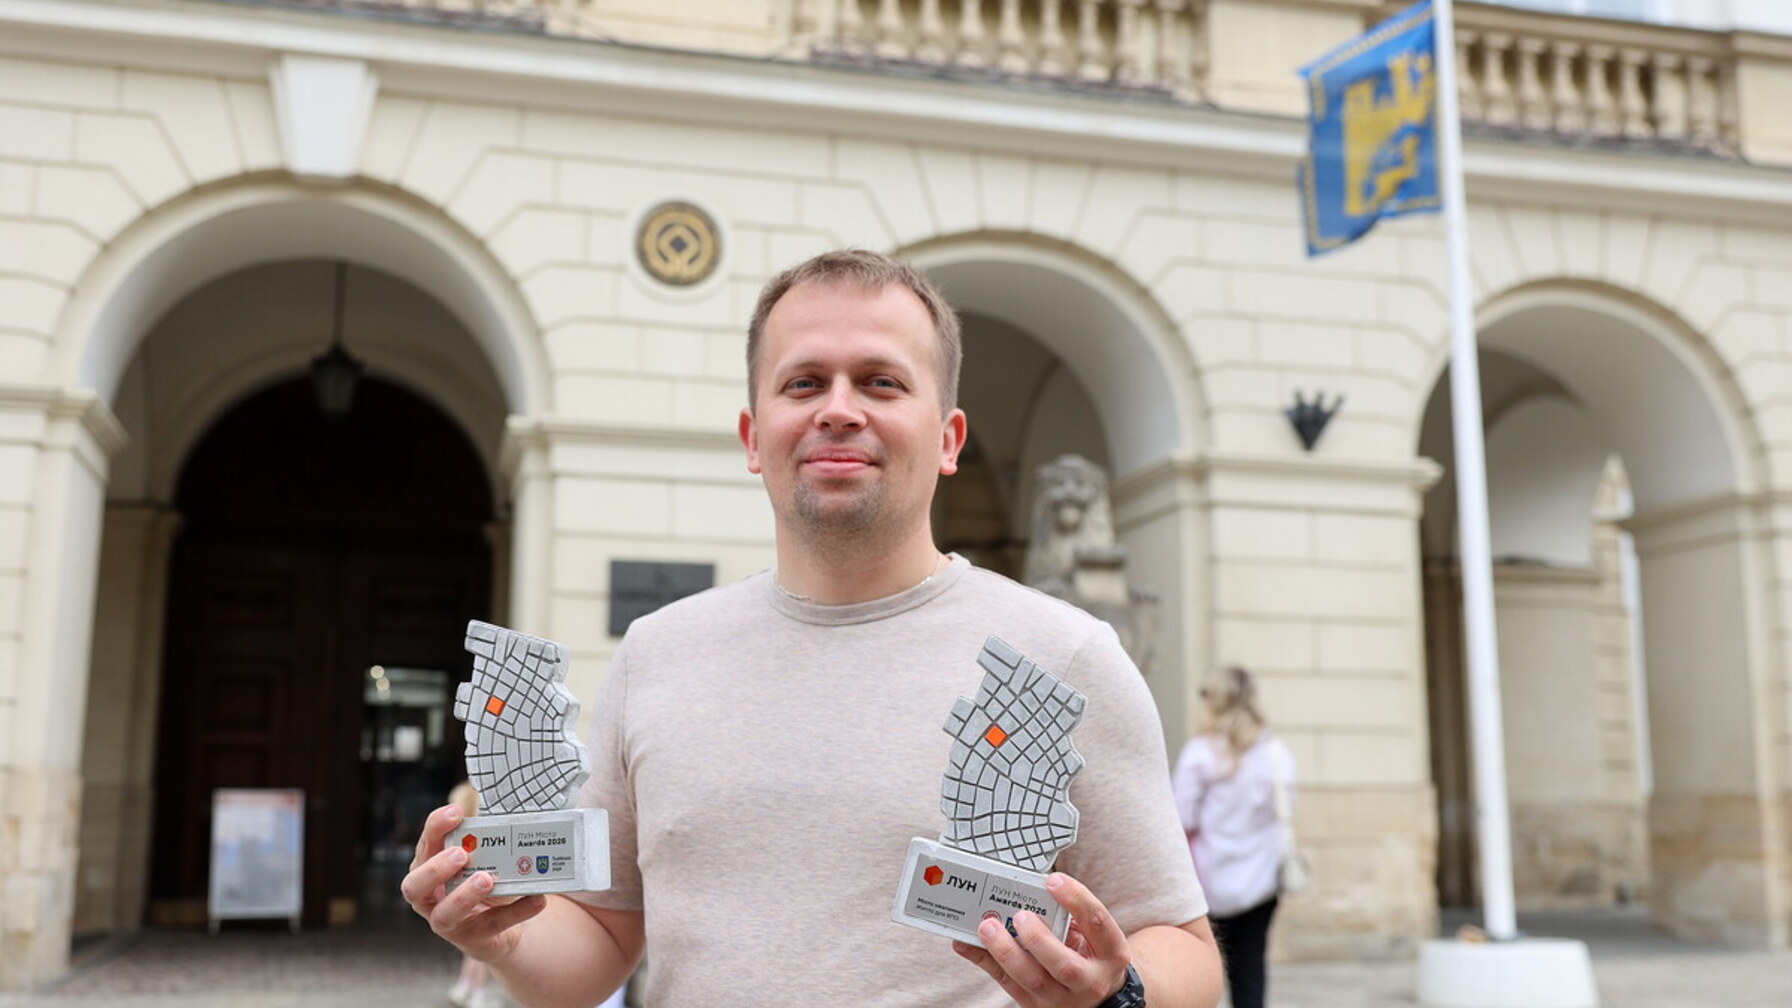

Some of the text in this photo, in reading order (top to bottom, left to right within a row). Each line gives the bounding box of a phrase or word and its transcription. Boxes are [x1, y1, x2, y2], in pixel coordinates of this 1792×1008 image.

[480, 836, 506, 848] ЛУН
[518, 837, 567, 847] Awards 2026
[946, 875, 978, 893] ЛУН
[991, 885, 1038, 905] ЛУН Місто
[989, 893, 1047, 916] Awards 2026
[946, 912, 959, 921] ВПО
